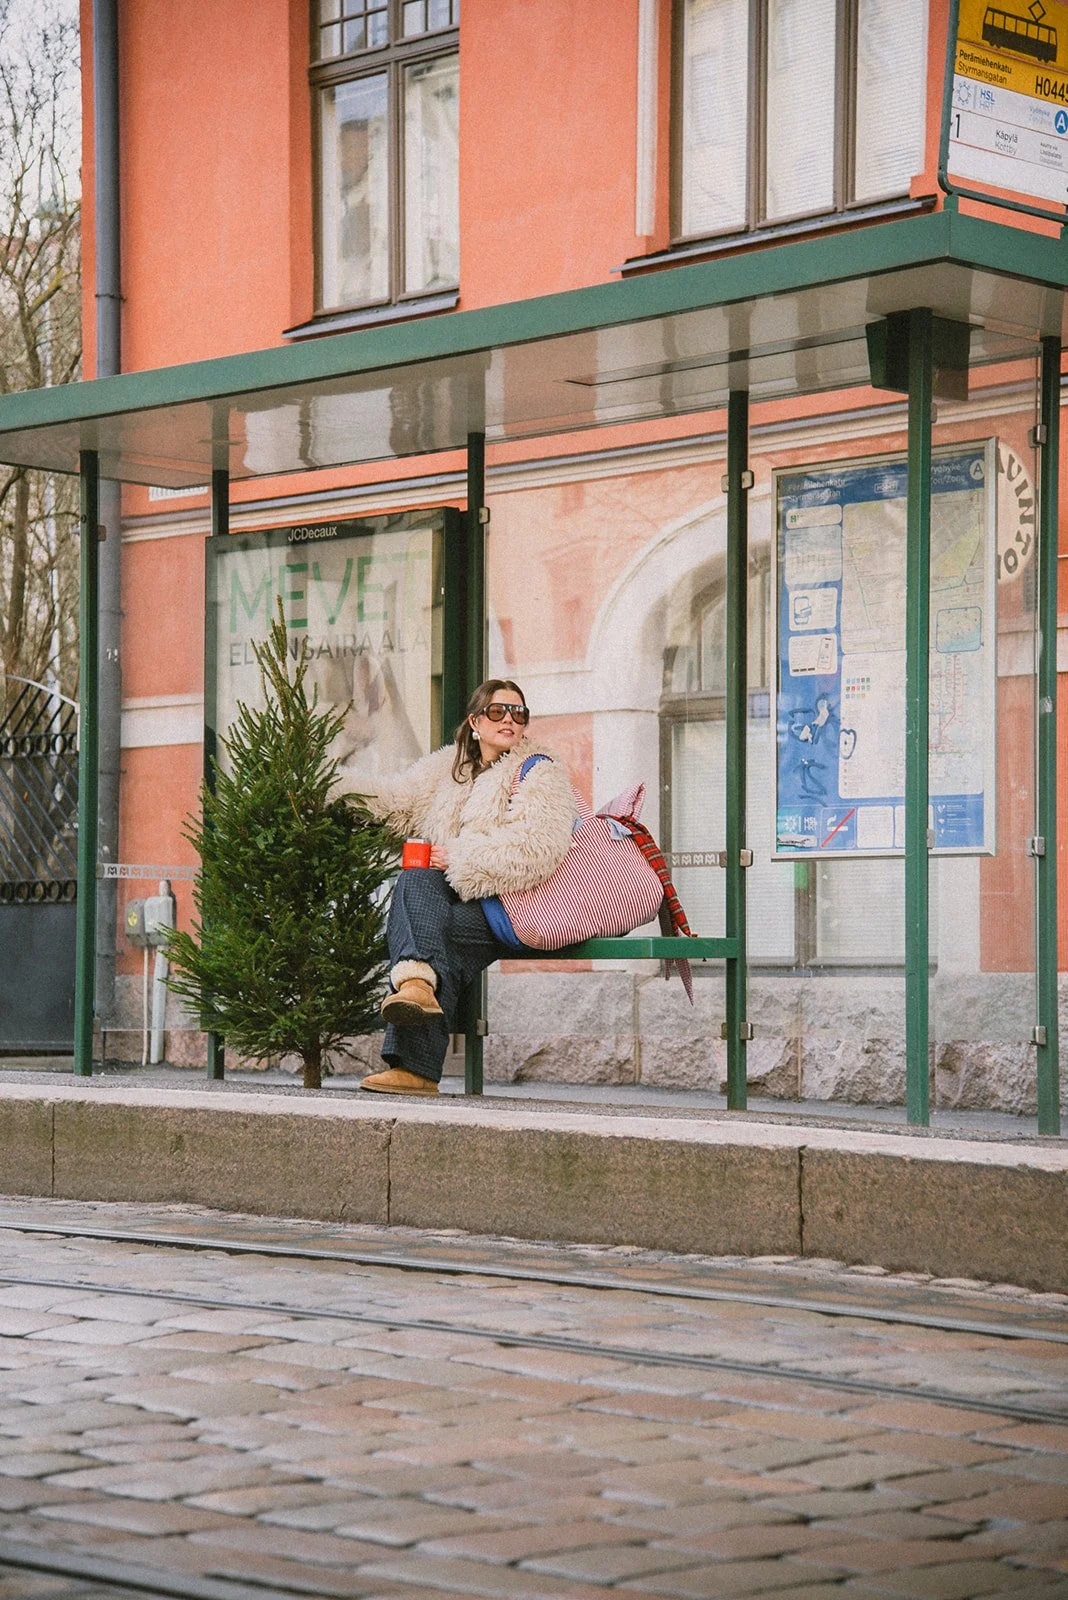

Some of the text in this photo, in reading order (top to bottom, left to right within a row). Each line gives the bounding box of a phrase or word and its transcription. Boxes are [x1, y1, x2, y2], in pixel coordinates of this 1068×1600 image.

[958, 62, 1007, 84] Styrmansgatan
[959, 49, 1012, 74] Perämiehenkatu
[980, 88, 995, 102] HSL
[955, 113, 961, 138] 1
[288, 525, 338, 542] JCDecaux
[229, 629, 427, 667] ELNSAIRAALA
